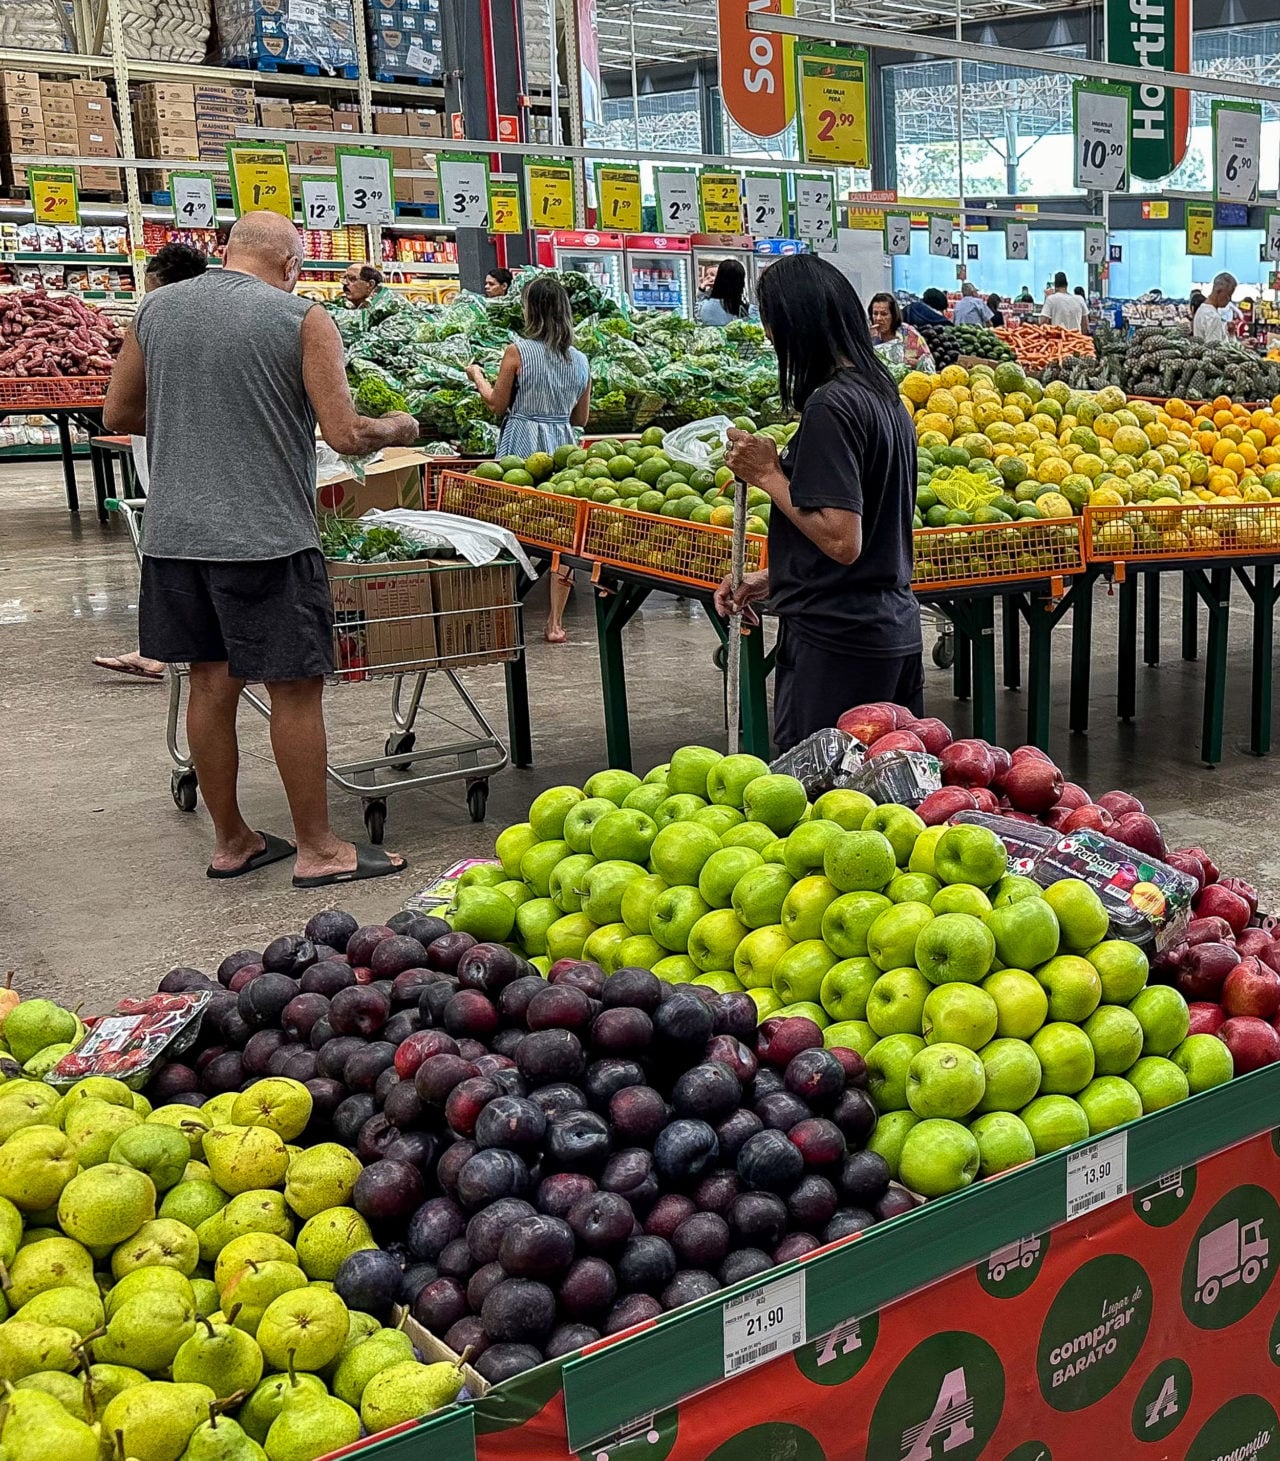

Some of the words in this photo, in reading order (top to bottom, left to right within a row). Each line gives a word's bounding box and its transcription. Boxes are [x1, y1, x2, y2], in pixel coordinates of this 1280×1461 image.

[1073, 846, 1120, 872] Perboni
[1084, 1162, 1111, 1185] 13,90
[1101, 1296, 1129, 1319] Lugar
[1131, 1285, 1143, 1303] de
[747, 1306, 783, 1336] 21,90
[1050, 1307, 1135, 1365] comprar
[1052, 1338, 1117, 1388] BARATO
